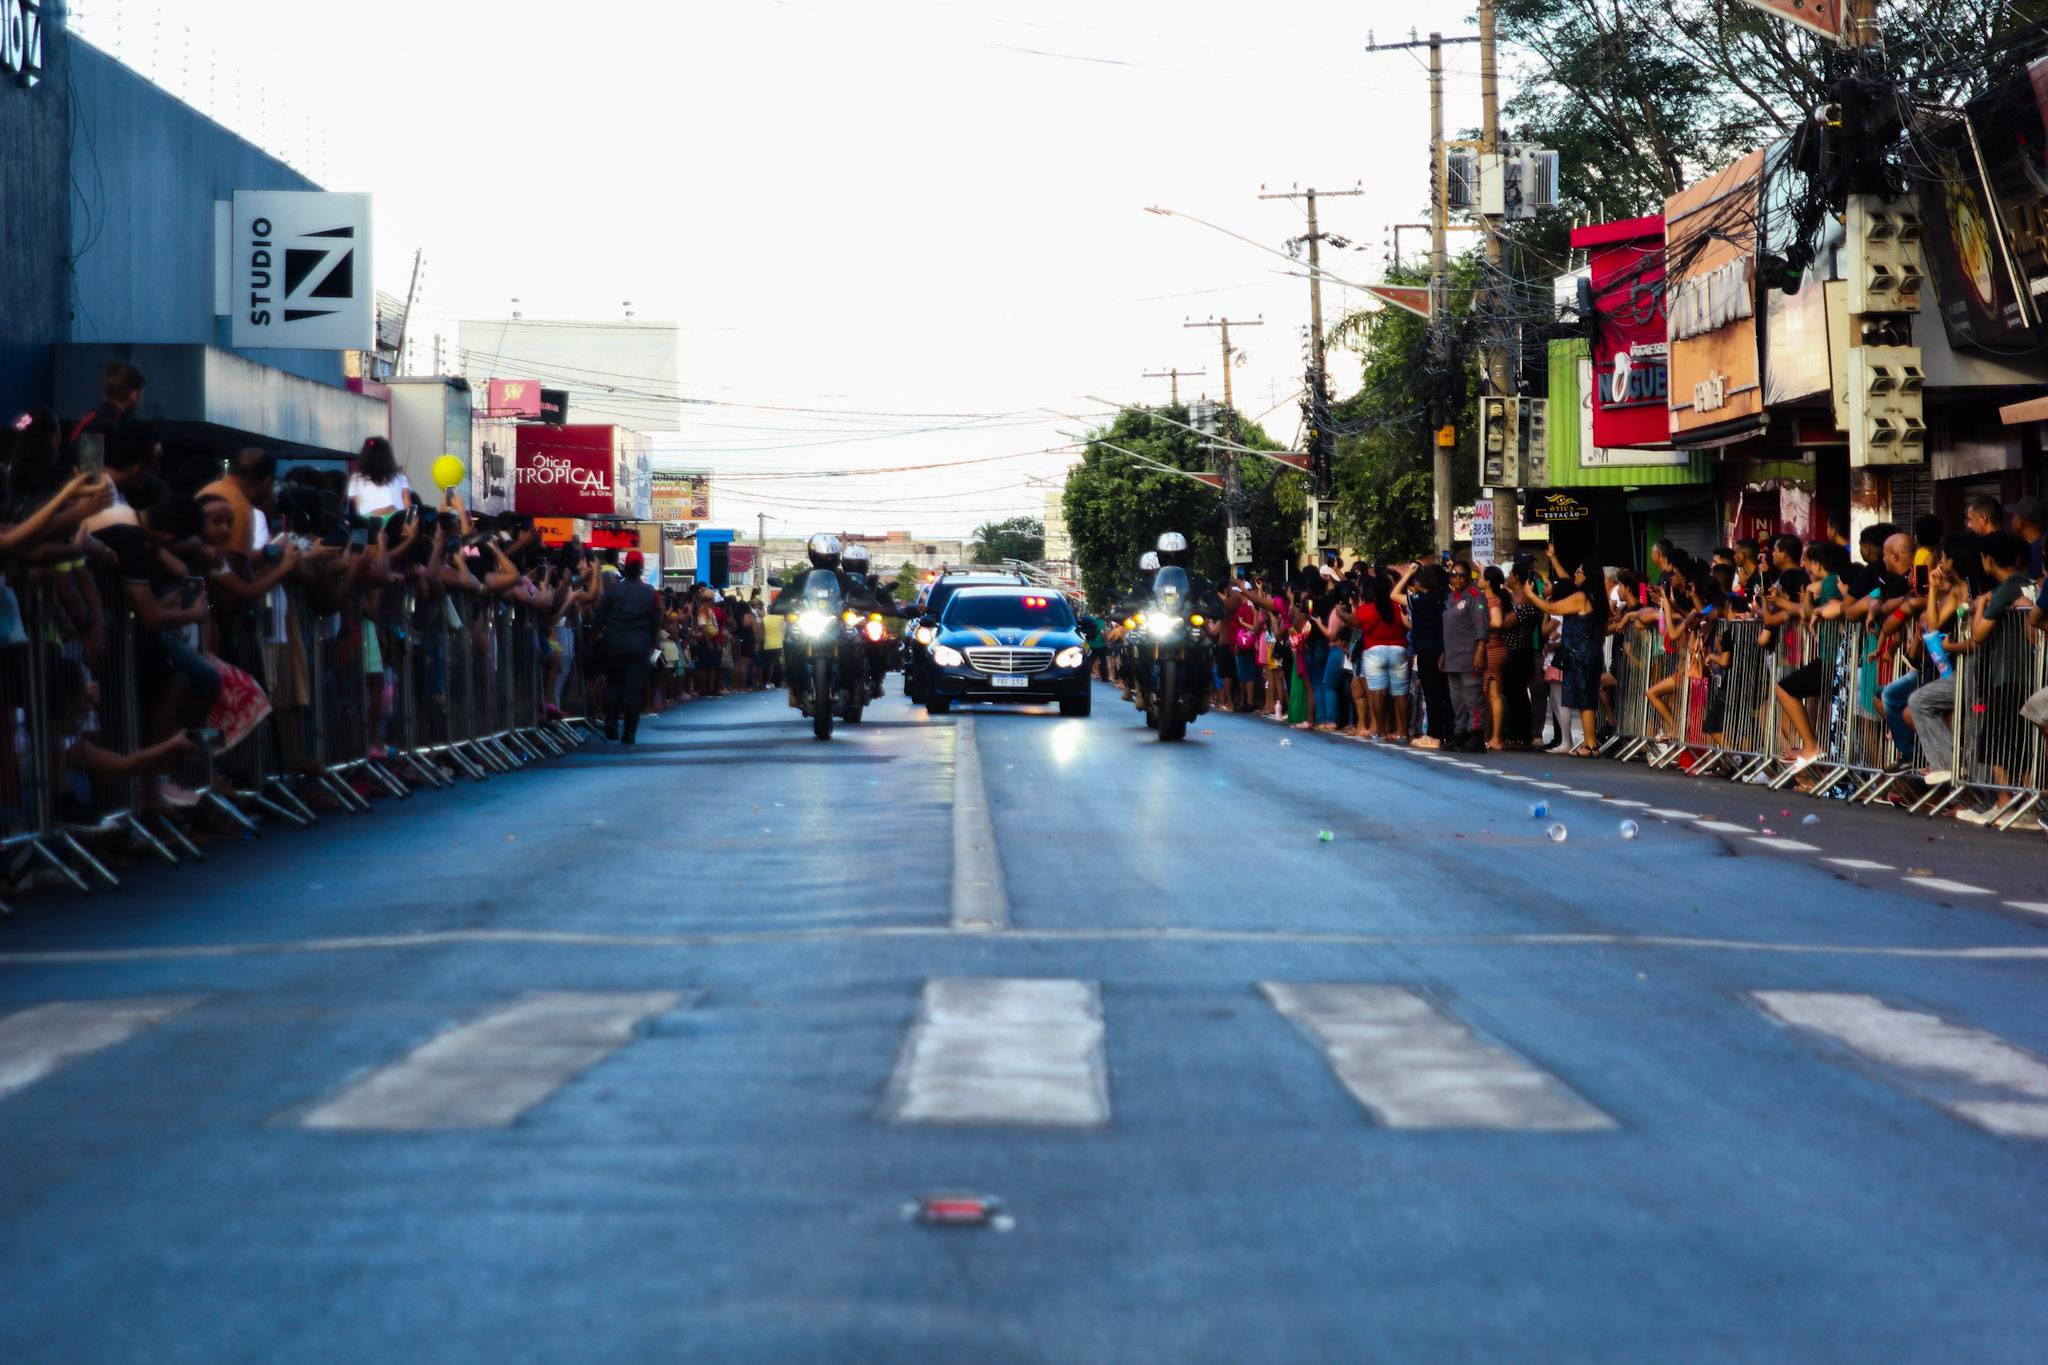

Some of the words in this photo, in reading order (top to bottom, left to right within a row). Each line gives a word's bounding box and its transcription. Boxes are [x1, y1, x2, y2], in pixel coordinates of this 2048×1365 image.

[251, 217, 272, 326] STUDIO
[532, 451, 571, 470] Ótica
[516, 467, 610, 490] TROPICAL
[597, 489, 613, 497] Grau
